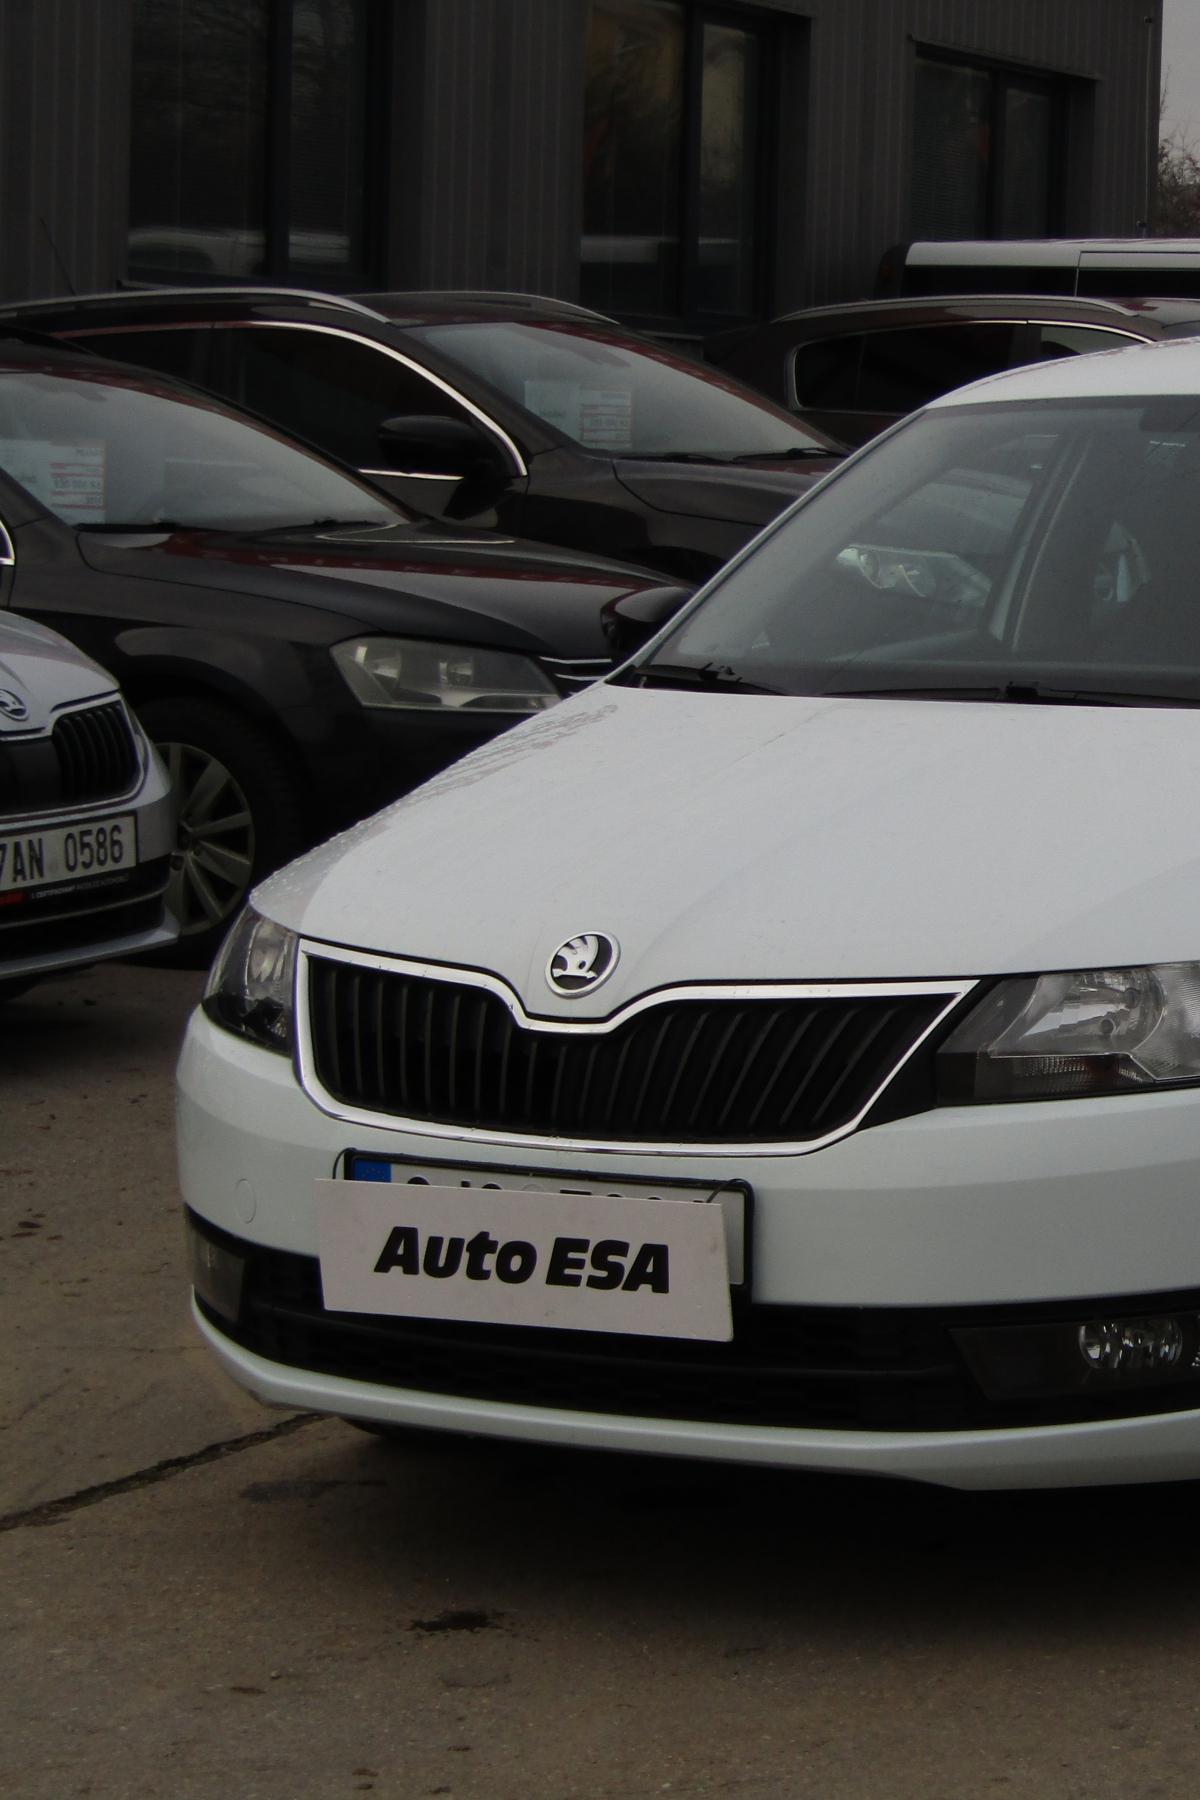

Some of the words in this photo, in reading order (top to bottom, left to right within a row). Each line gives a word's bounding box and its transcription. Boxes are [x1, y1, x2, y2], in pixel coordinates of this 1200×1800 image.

[64, 824, 123, 873] 0586
[373, 1226, 537, 1284] Auto
[545, 1237, 670, 1294] ESA
